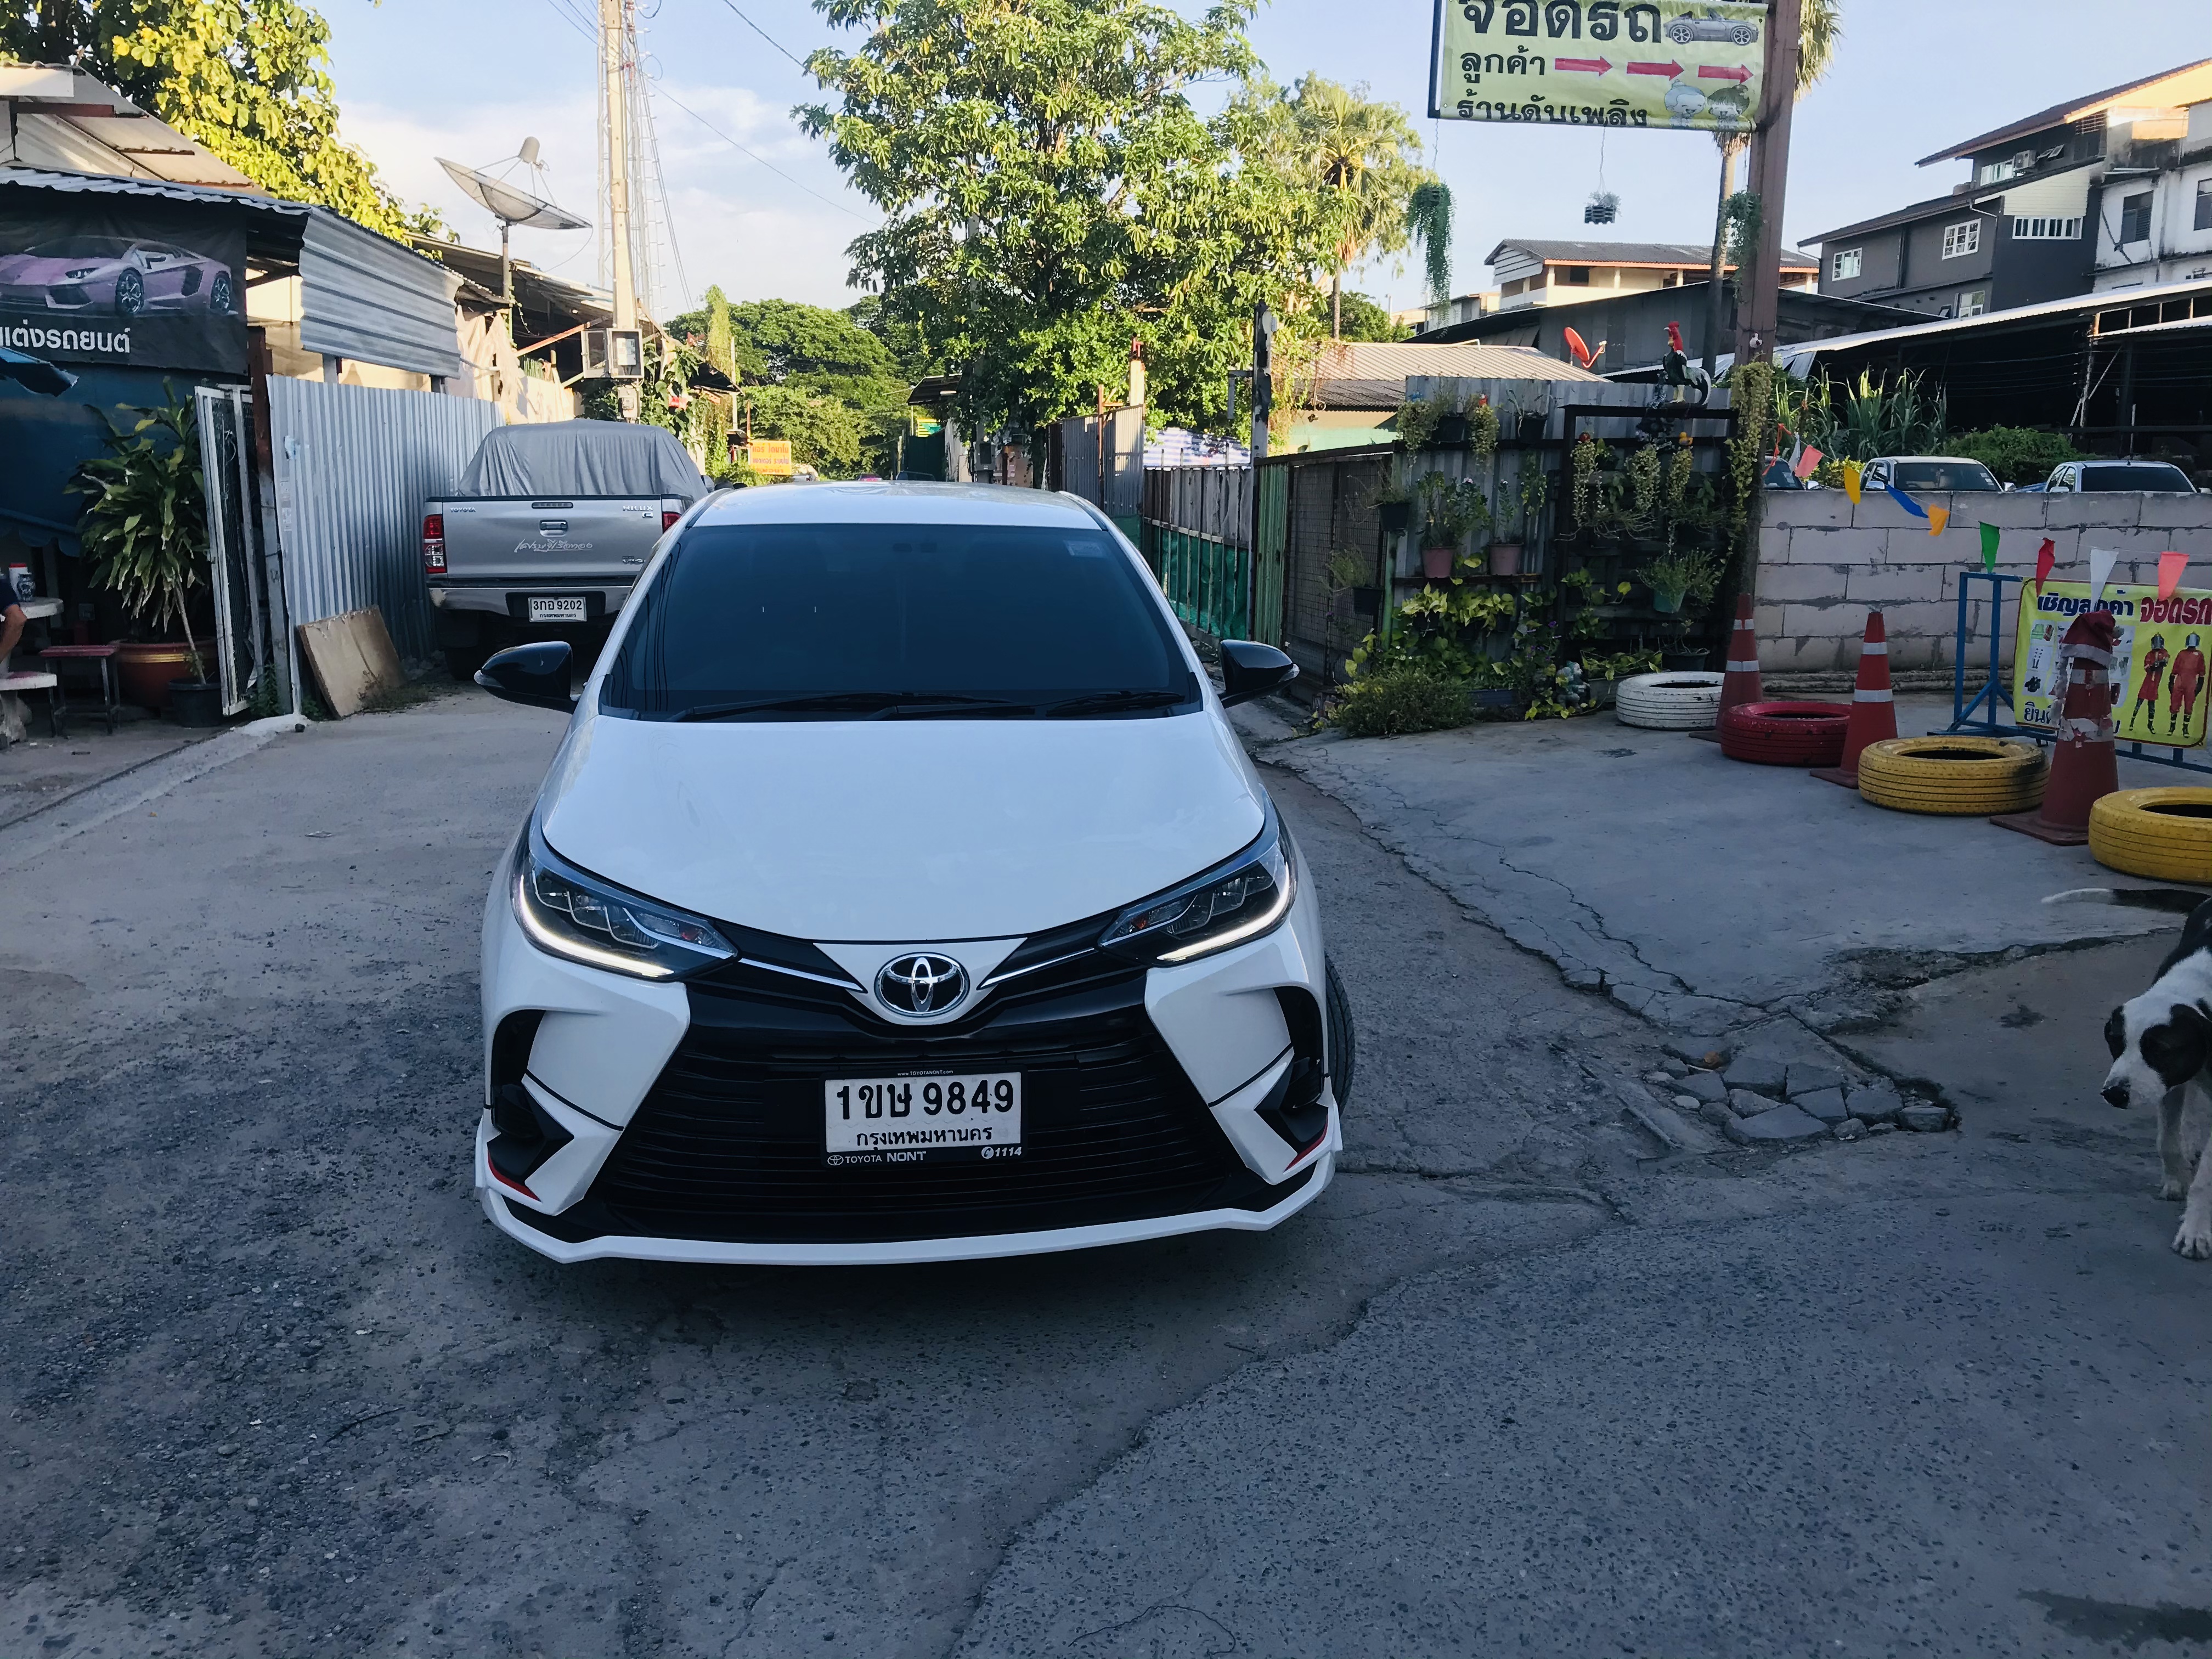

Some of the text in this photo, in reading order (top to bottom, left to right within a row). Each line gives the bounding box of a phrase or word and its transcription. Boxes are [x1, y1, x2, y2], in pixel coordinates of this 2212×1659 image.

[1459, 0, 1661, 43] จอดรถ
[1460, 45, 1545, 83] ลูกค้า
[1457, 88, 1647, 127] ร้านดับเพลิง
[0, 319, 131, 353] แต่งรถยนต์
[556, 600, 582, 610] 9202
[837, 1080, 1013, 1120] 1ขษ 9849
[845, 1147, 1022, 1164] TOYOTA NONT 1114
[856, 1127, 992, 1150] กรุงเทพมหานคร
